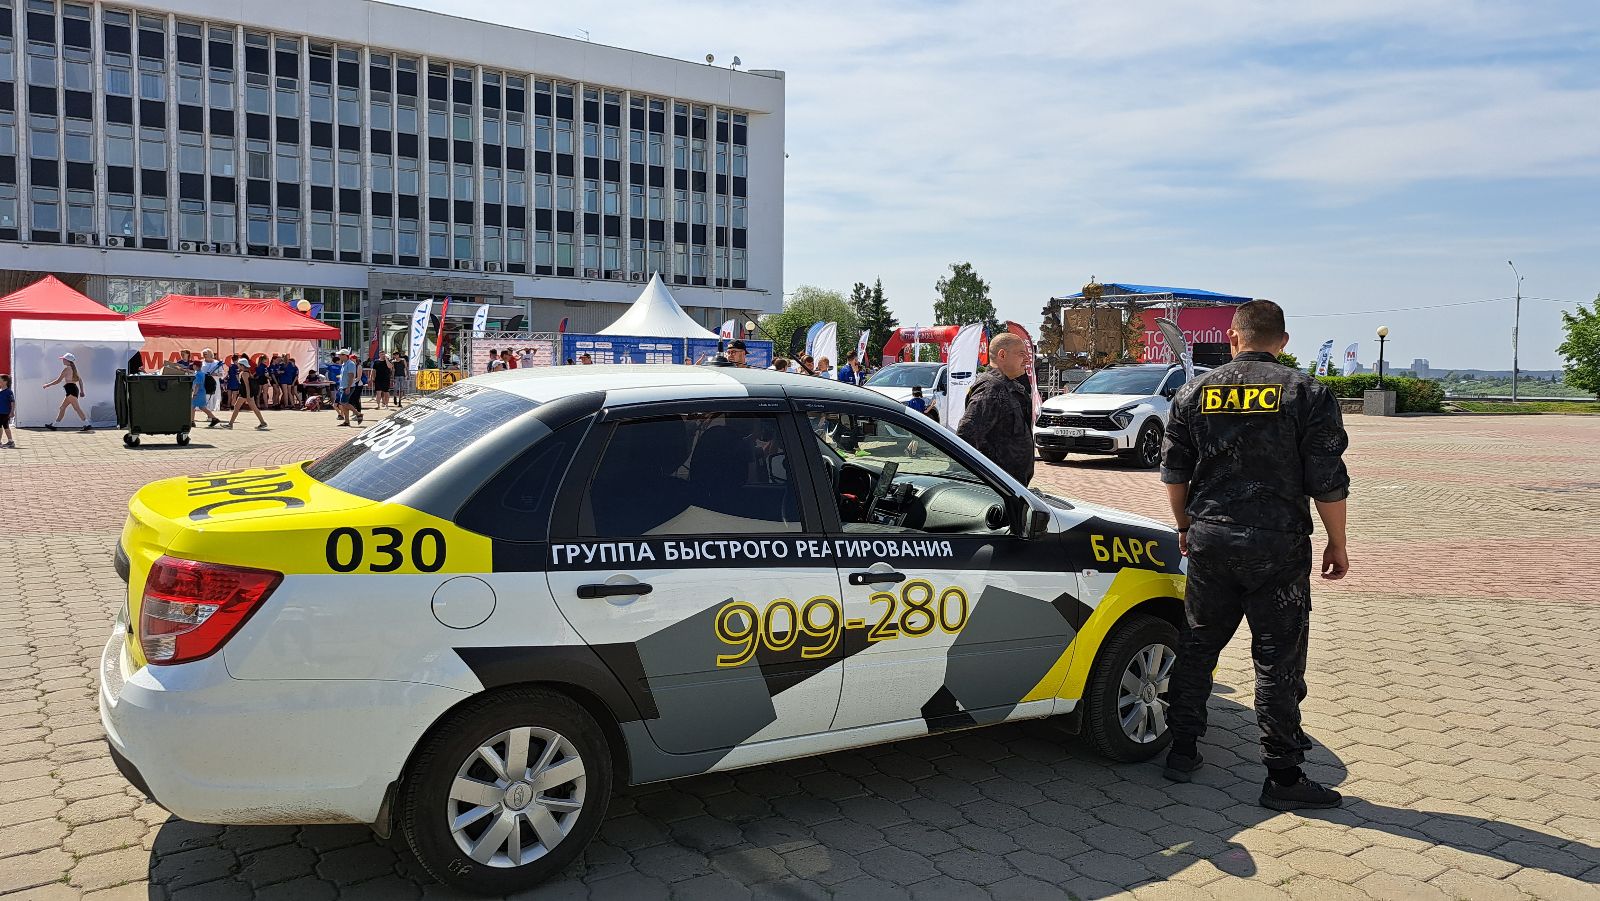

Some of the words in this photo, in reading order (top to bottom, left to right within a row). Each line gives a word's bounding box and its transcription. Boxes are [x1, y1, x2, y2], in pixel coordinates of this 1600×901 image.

[1205, 387, 1276, 410] БАРС
[325, 526, 447, 573] 030
[551, 542, 656, 564] ГРУППА
[663, 540, 788, 560] БЫСТРОГО
[796, 540, 953, 558] РЕАГИРОВАНИЯ
[1090, 534, 1166, 567] БАРС
[714, 578, 969, 667] 909-280
